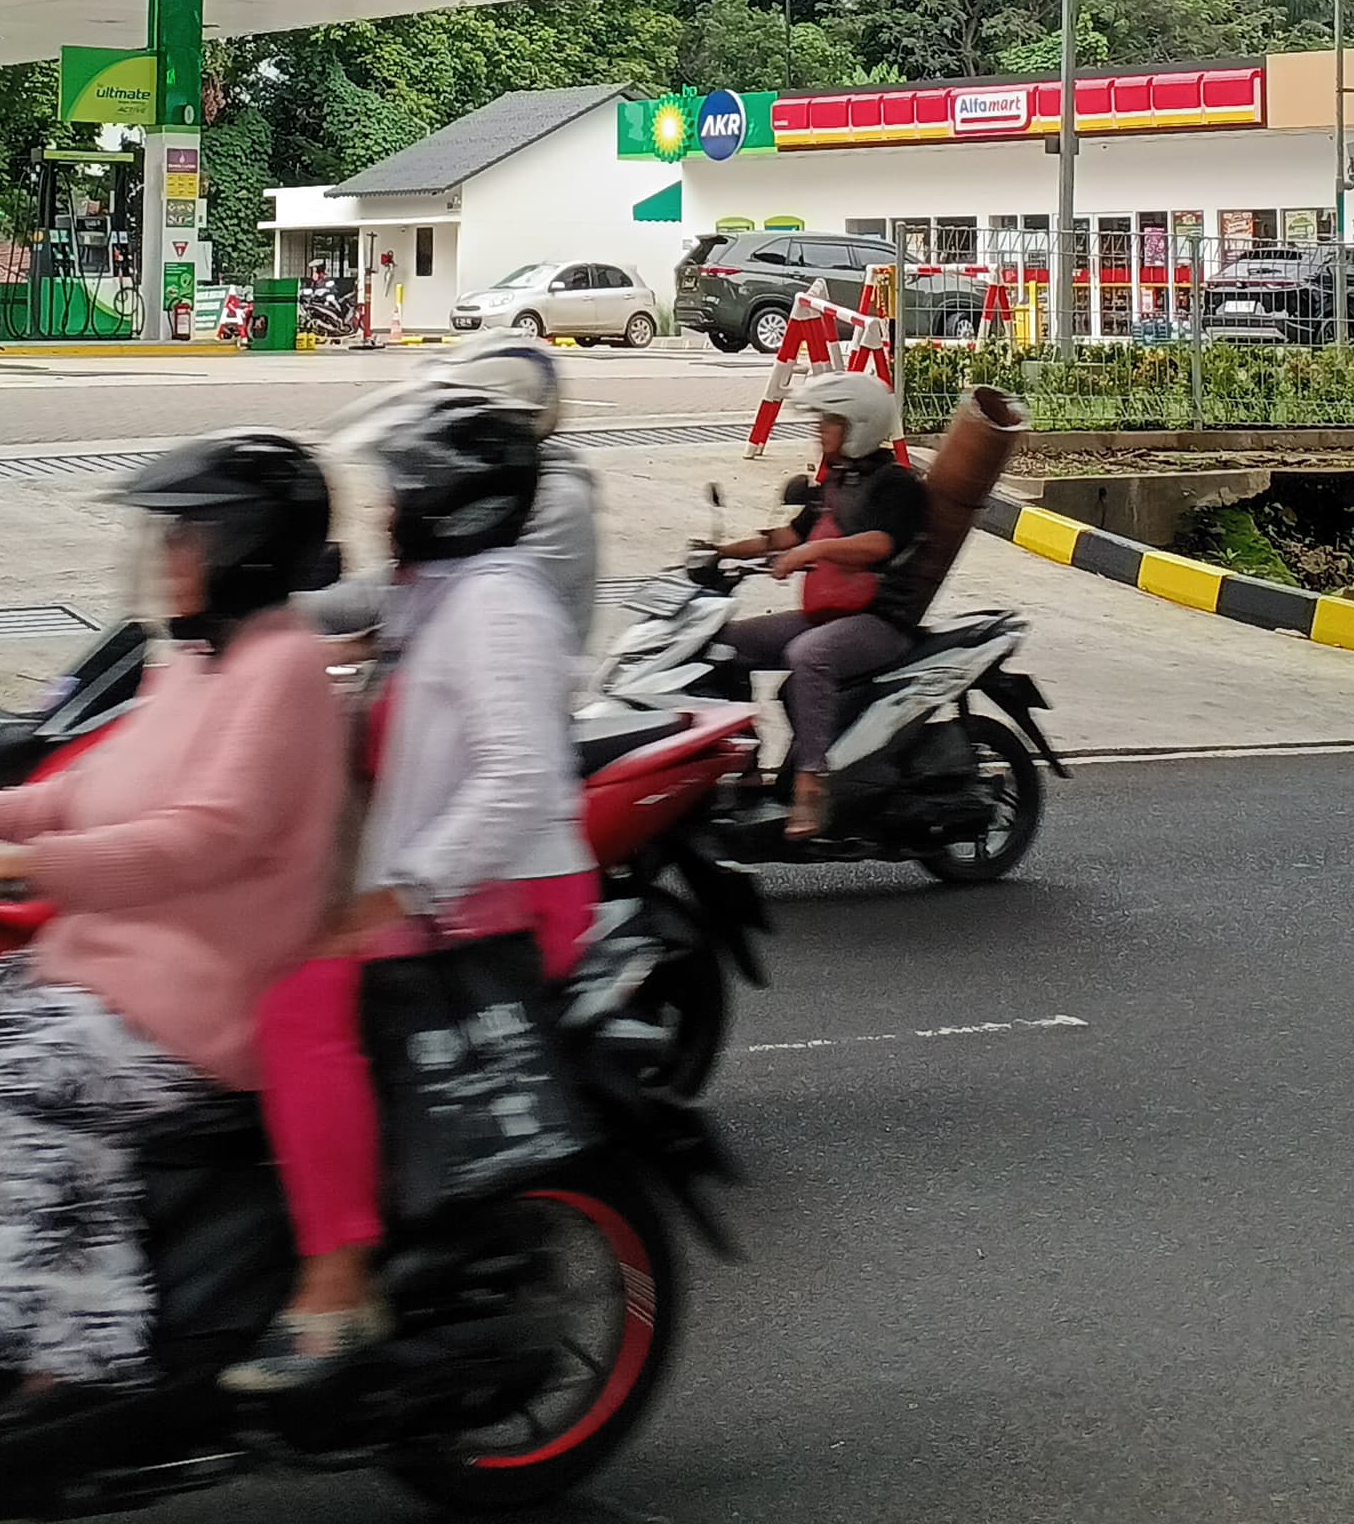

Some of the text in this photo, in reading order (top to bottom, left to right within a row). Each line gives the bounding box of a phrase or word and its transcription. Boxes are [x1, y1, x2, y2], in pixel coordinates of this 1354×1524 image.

[96, 86, 151, 100] ultimate
[959, 95, 1022, 114] Alfamart
[700, 113, 741, 137] AKR
